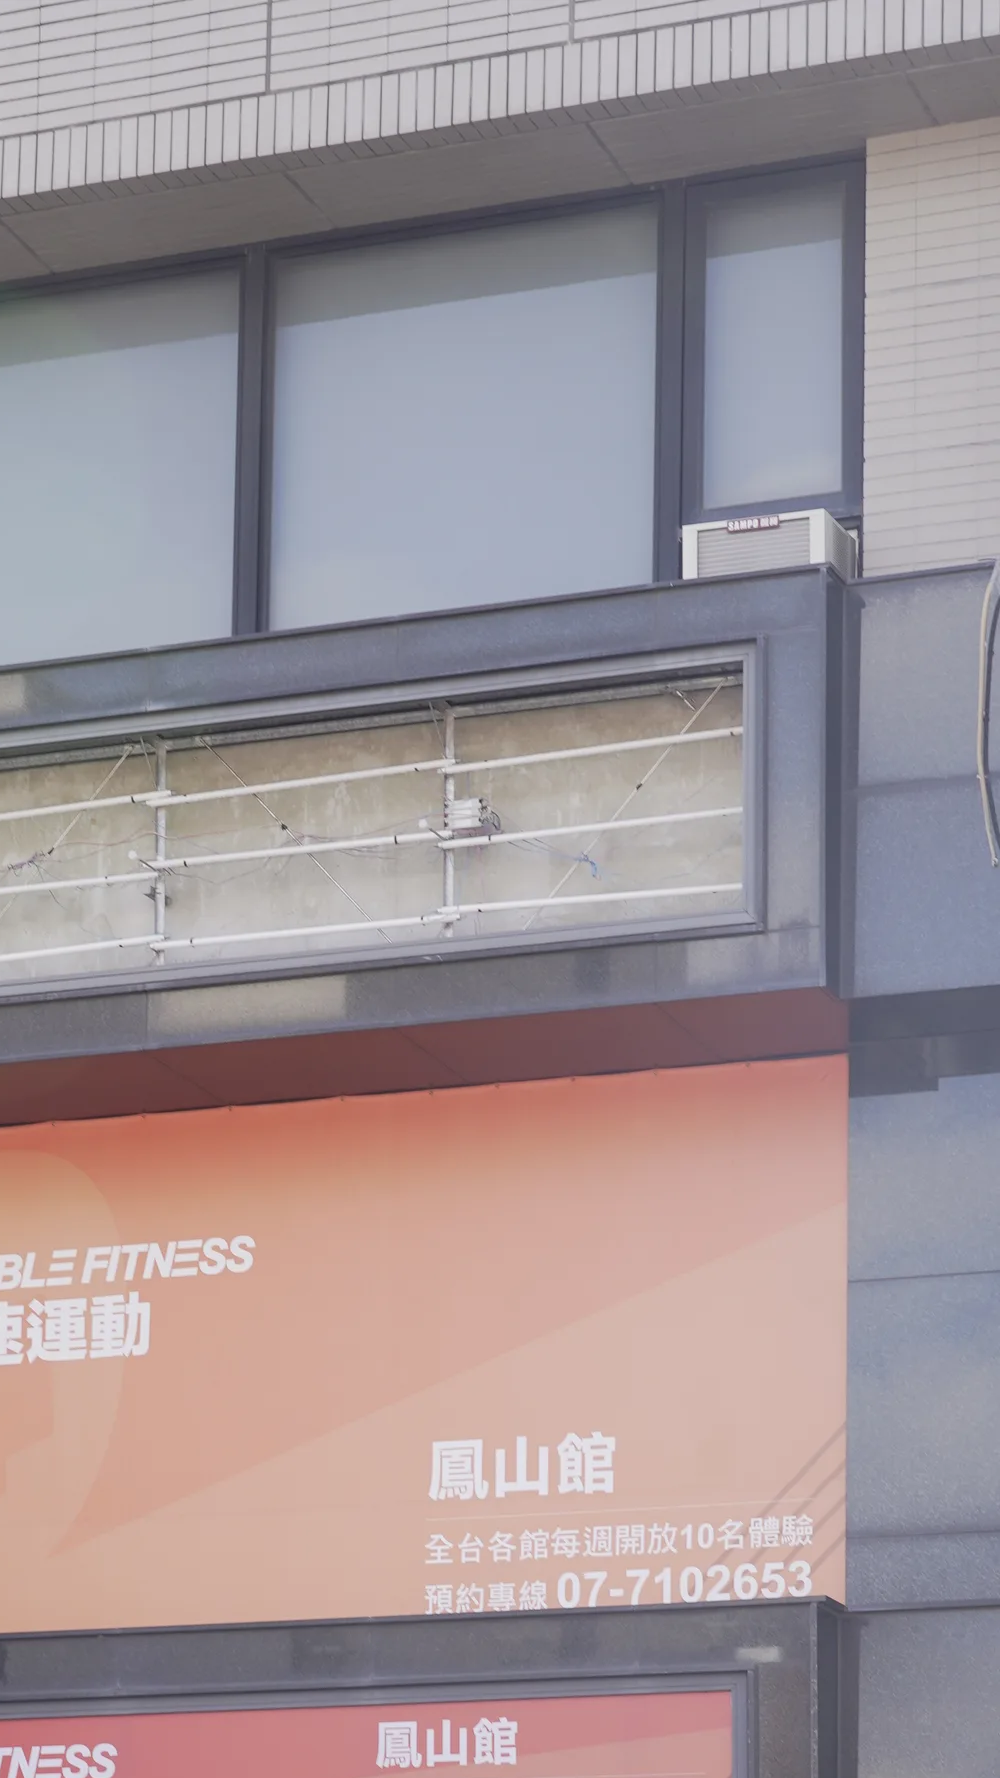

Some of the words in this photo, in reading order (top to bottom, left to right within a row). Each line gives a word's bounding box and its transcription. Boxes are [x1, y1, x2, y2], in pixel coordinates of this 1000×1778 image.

[728, 518, 759, 531] SAMPO
[81, 1235, 257, 1283] FITNESS
[428, 1431, 617, 1502] 鳳山館
[424, 1513, 815, 1566] 全台各館每週開放10名體驗
[424, 1580, 548, 1616] 預約專線
[557, 1560, 813, 1609] 07-7102653
[375, 1716, 519, 1770] 鳳山館
